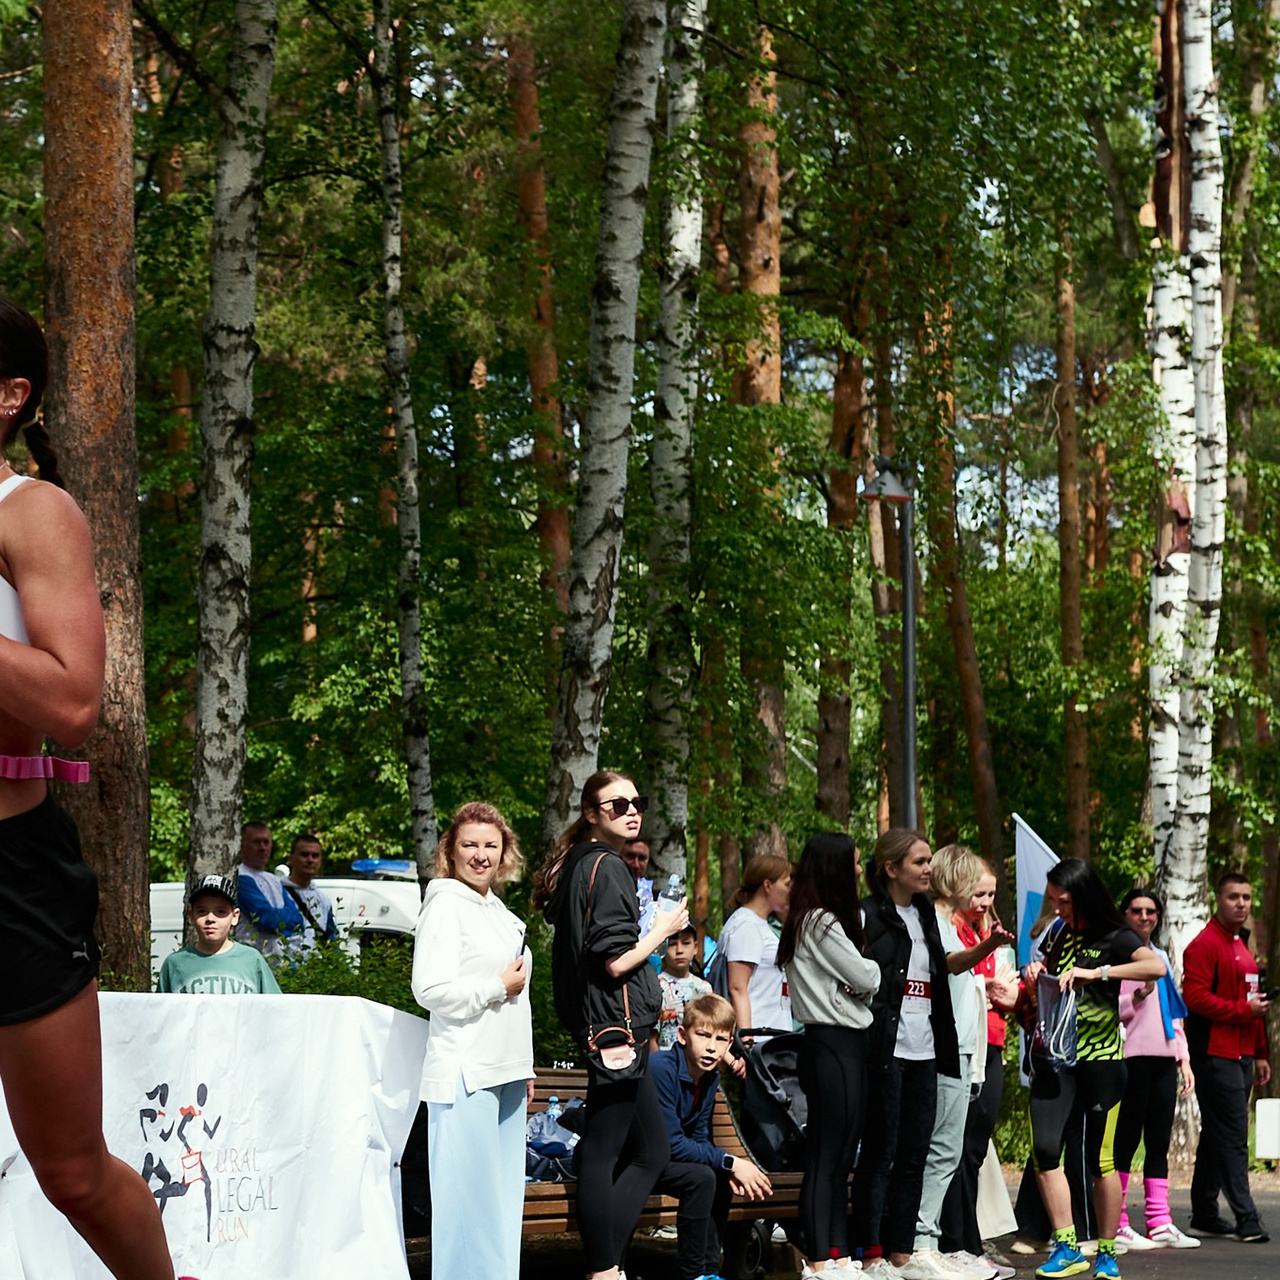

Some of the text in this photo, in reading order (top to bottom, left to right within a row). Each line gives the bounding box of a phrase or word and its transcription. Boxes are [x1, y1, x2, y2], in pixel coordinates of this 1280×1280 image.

[358, 904, 366, 917] 2
[908, 981, 925, 996] 223
[214, 1147, 261, 1173] URAL
[216, 1176, 279, 1213] LEGAL
[217, 1217, 249, 1242] RUN
